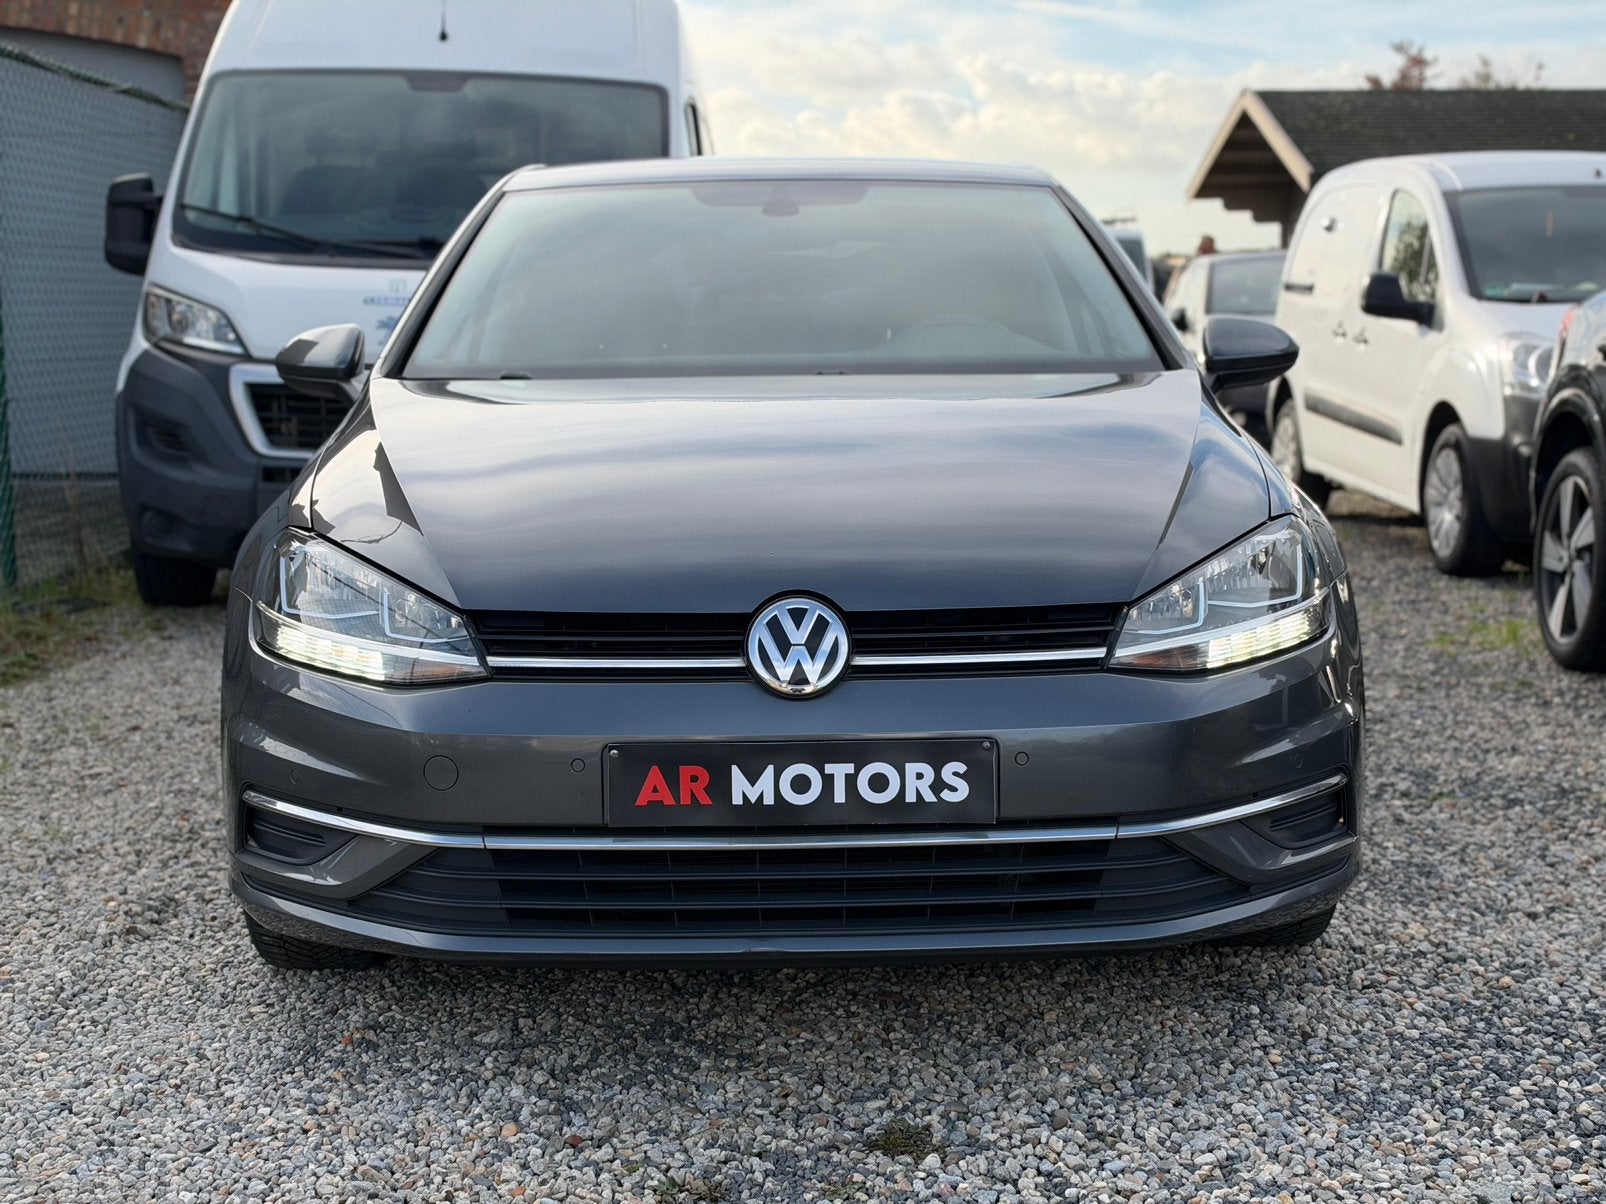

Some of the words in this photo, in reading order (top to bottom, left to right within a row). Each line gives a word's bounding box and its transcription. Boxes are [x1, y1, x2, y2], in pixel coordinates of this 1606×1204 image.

[748, 597, 849, 695] VW
[636, 765, 713, 806] AR
[731, 761, 970, 805] MOTORS
